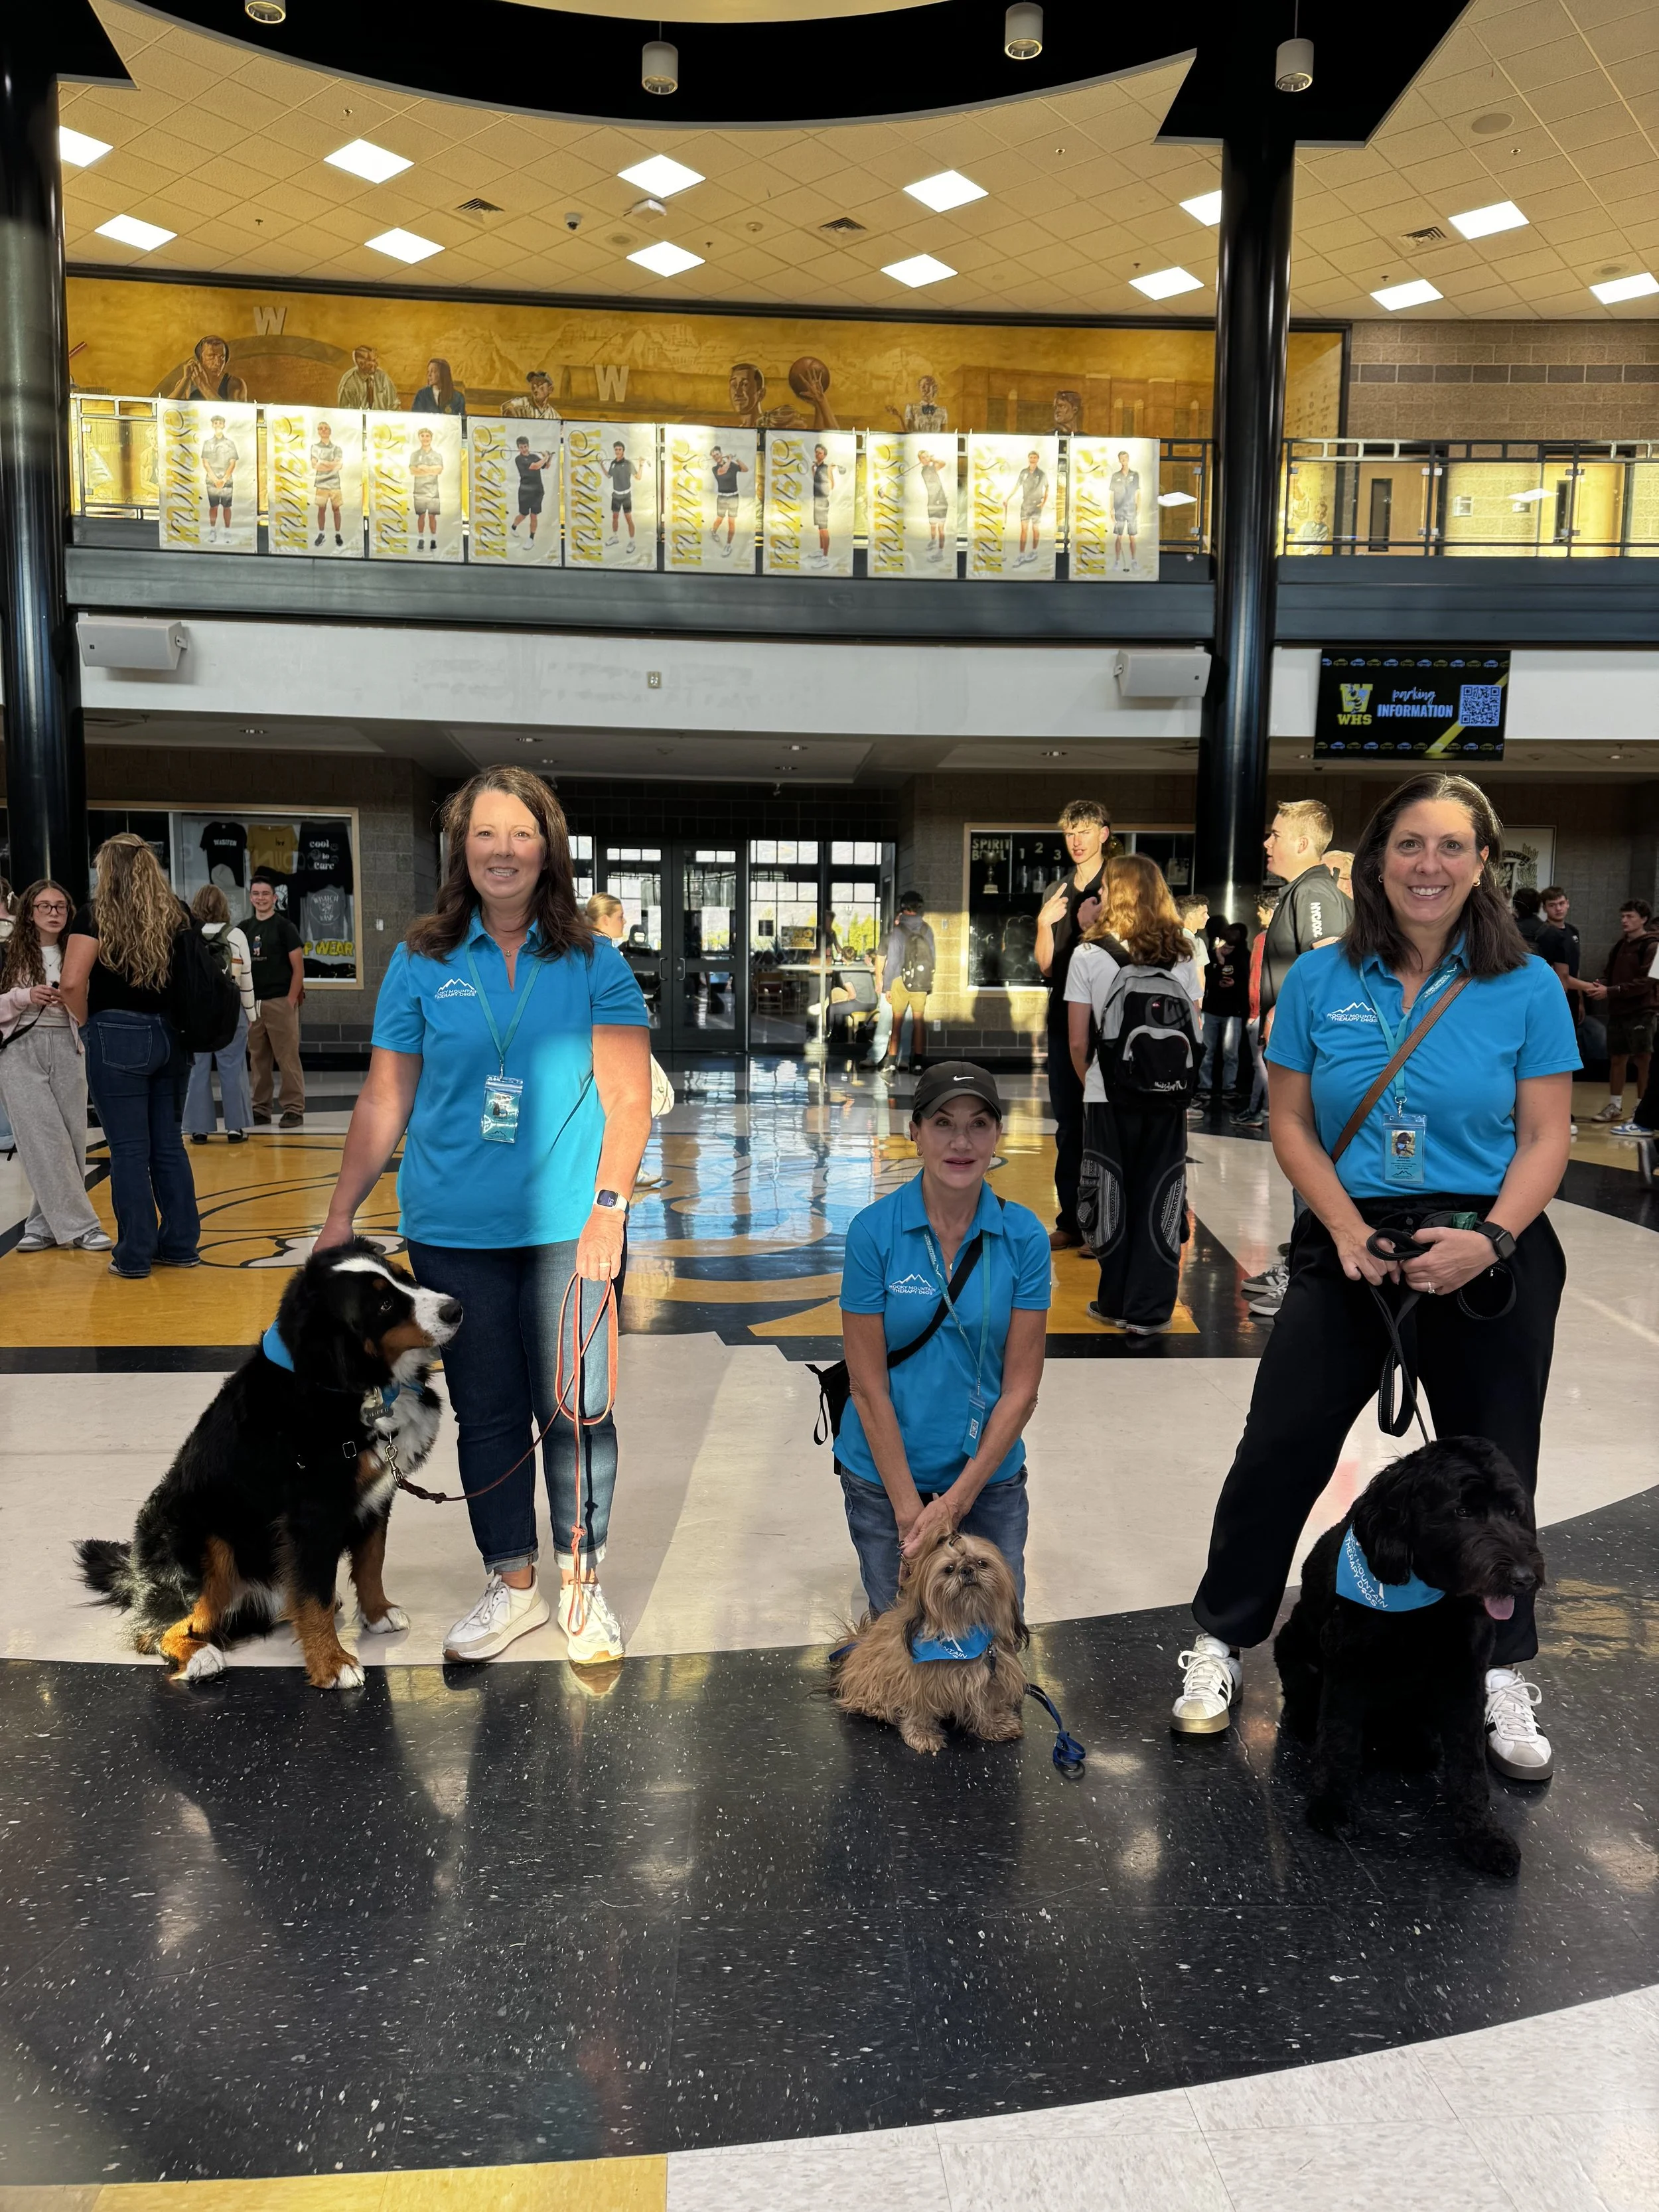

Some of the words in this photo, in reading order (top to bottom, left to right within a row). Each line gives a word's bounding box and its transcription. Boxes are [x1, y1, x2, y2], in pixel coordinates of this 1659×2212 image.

[253, 306, 287, 336] W
[595, 364, 630, 403] W
[473, 425, 507, 557] WASATCH
[570, 429, 603, 561] WASATCH
[1392, 686, 1436, 705] parking
[1377, 704, 1453, 717] INFORMATION
[1337, 714, 1372, 725] WHS
[309, 840, 330, 848] cool
[972, 838, 1011, 849] SPIRIT
[1035, 842, 1044, 853] 2
[1019, 848, 1025, 859] 1
[1053, 849, 1062, 861] 3
[316, 940, 354, 956] WEAR
[1344, 1536, 1360, 1578] THERAPY
[1356, 1558, 1389, 1609] MOUNTAIN
